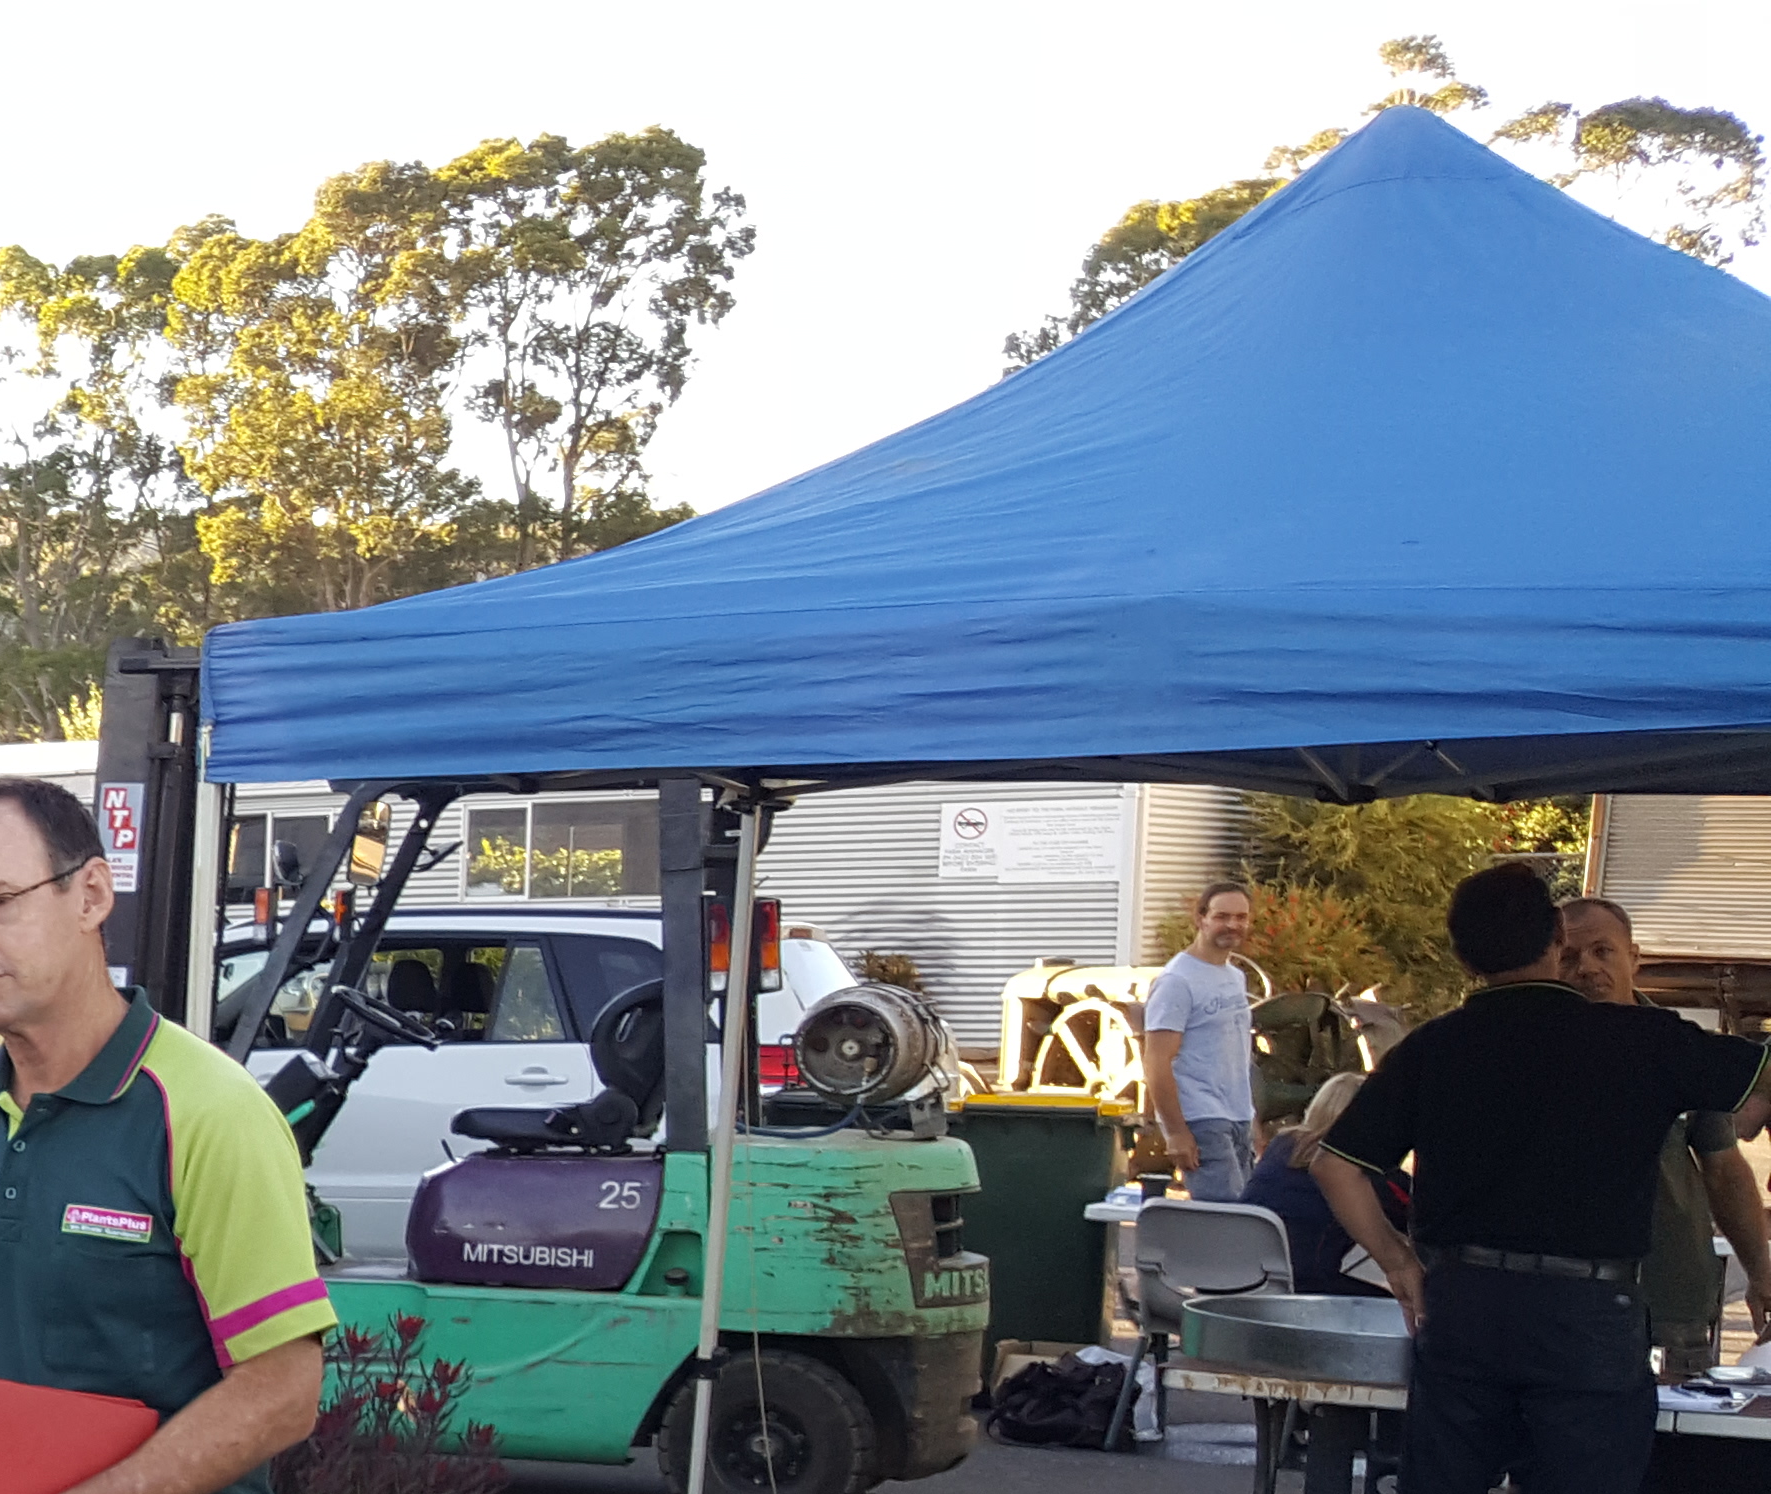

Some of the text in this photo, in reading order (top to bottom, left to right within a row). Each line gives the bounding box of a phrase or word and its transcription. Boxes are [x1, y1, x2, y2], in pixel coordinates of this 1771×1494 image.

[599, 1180, 642, 1209] 25
[81, 1211, 147, 1230] PlantsPlus
[463, 1242, 594, 1268] MITSUBISHI
[923, 1268, 989, 1299] MITS
